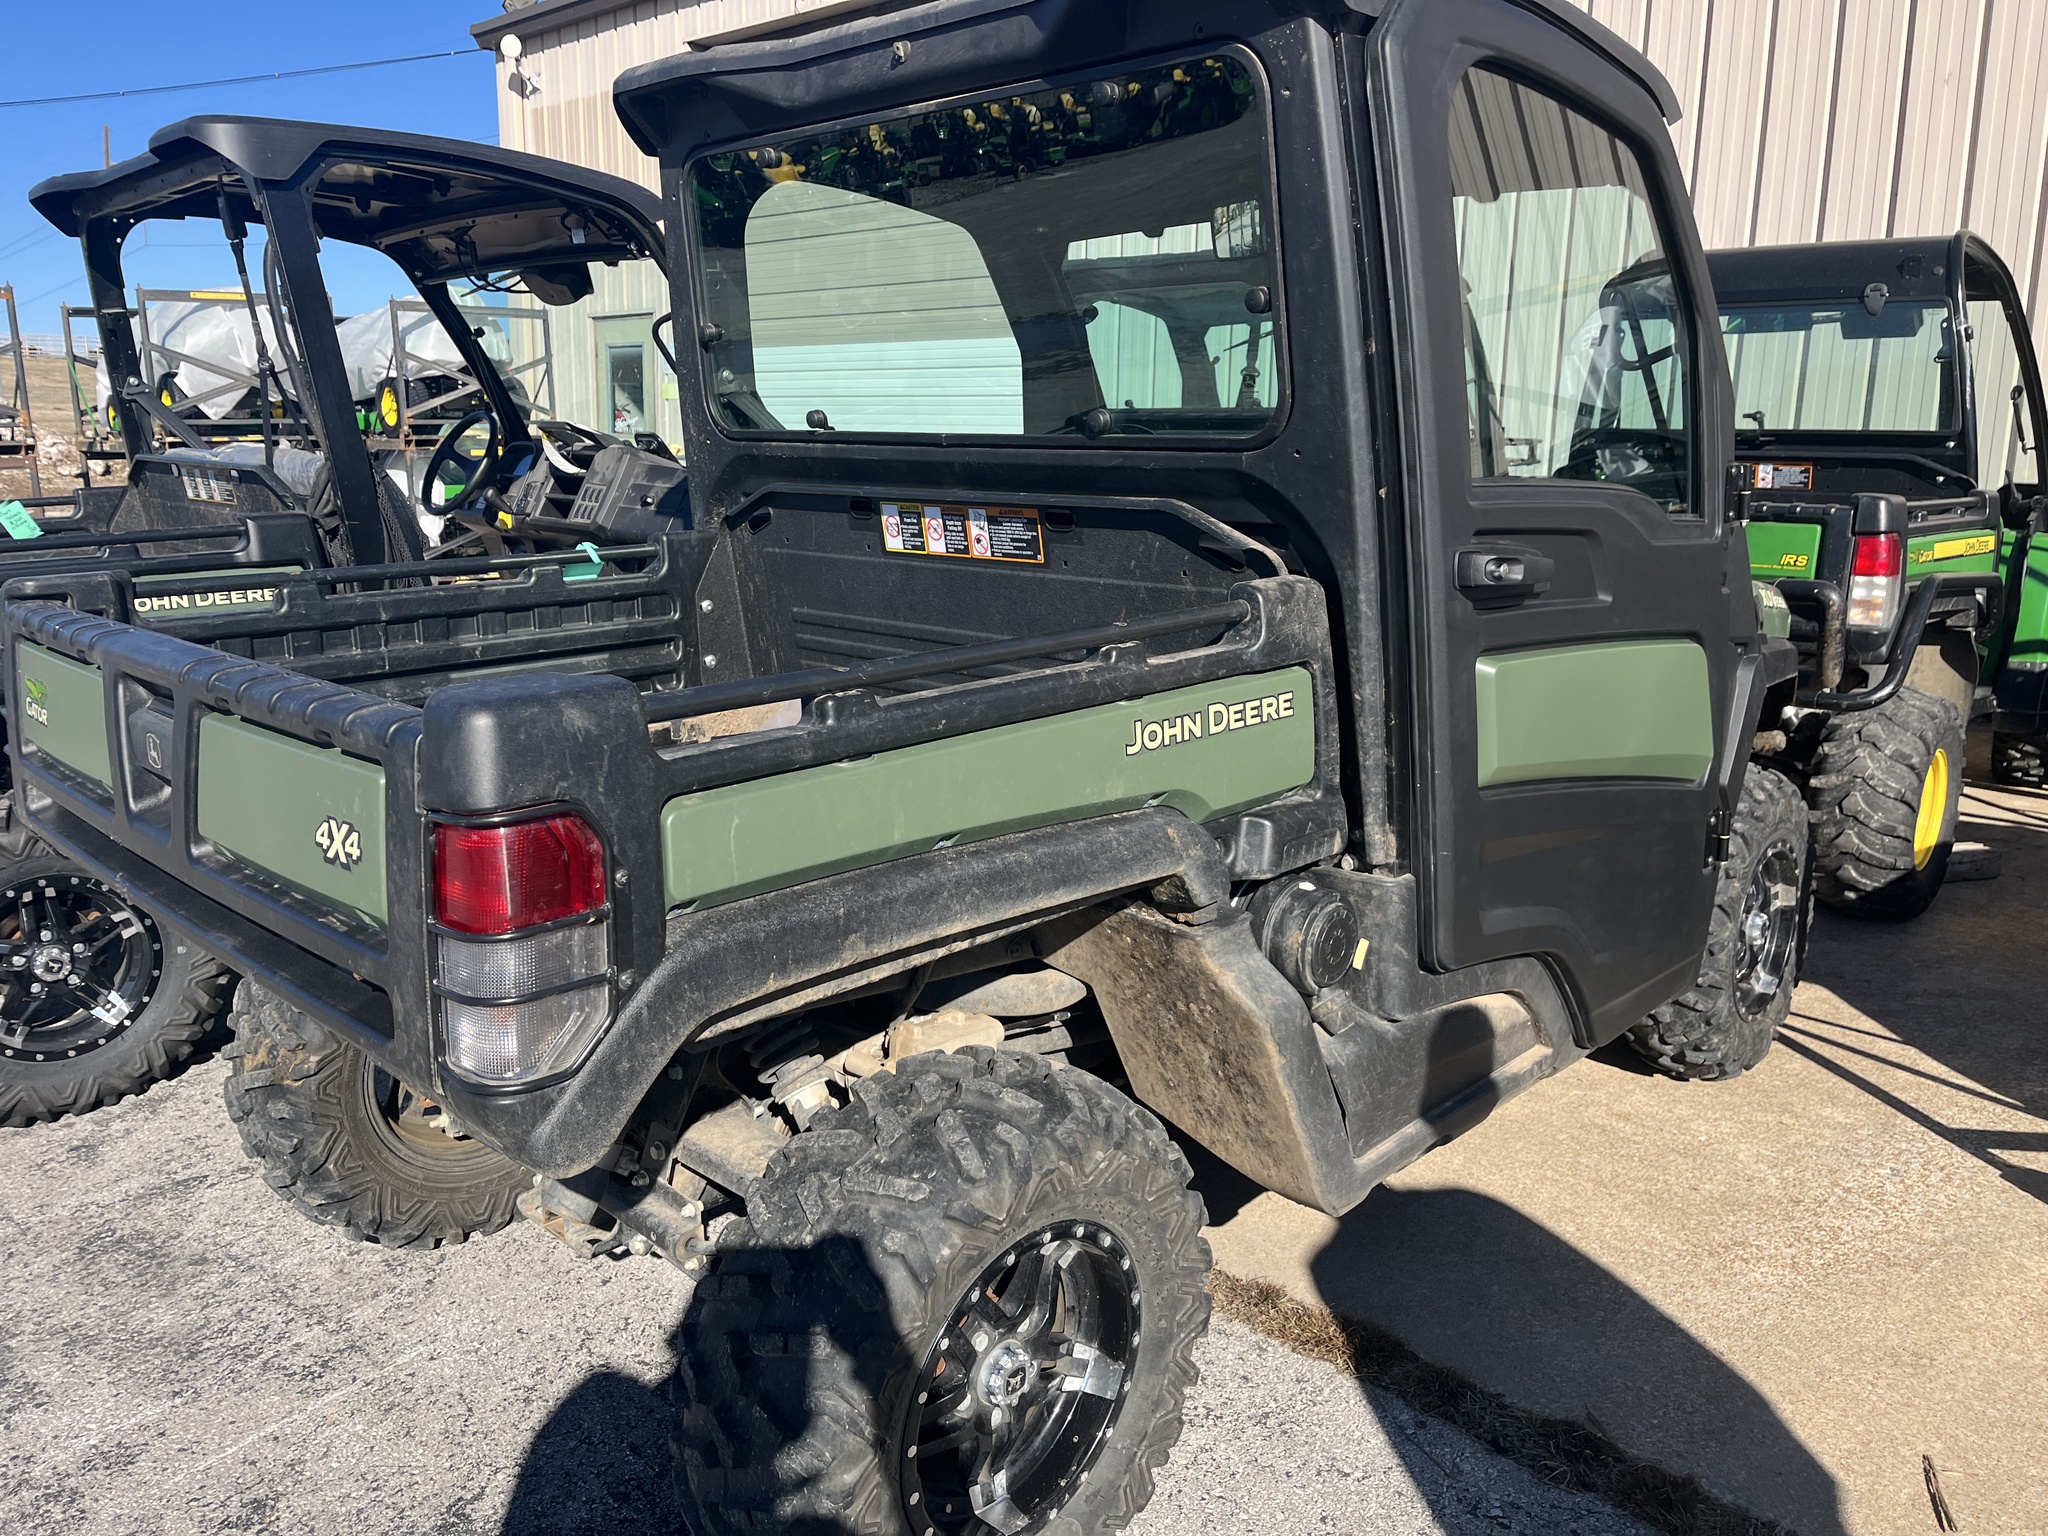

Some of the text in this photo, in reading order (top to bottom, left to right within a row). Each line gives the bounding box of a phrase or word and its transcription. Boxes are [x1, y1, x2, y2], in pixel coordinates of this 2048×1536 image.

[1780, 553, 1808, 567] IRS
[1963, 539, 1990, 556] JOHN DEERE
[133, 593, 190, 612] OHN
[26, 696, 48, 727] GATOR
[1125, 691, 1295, 756] JOHN DEERE
[315, 815, 362, 872] 4X4
